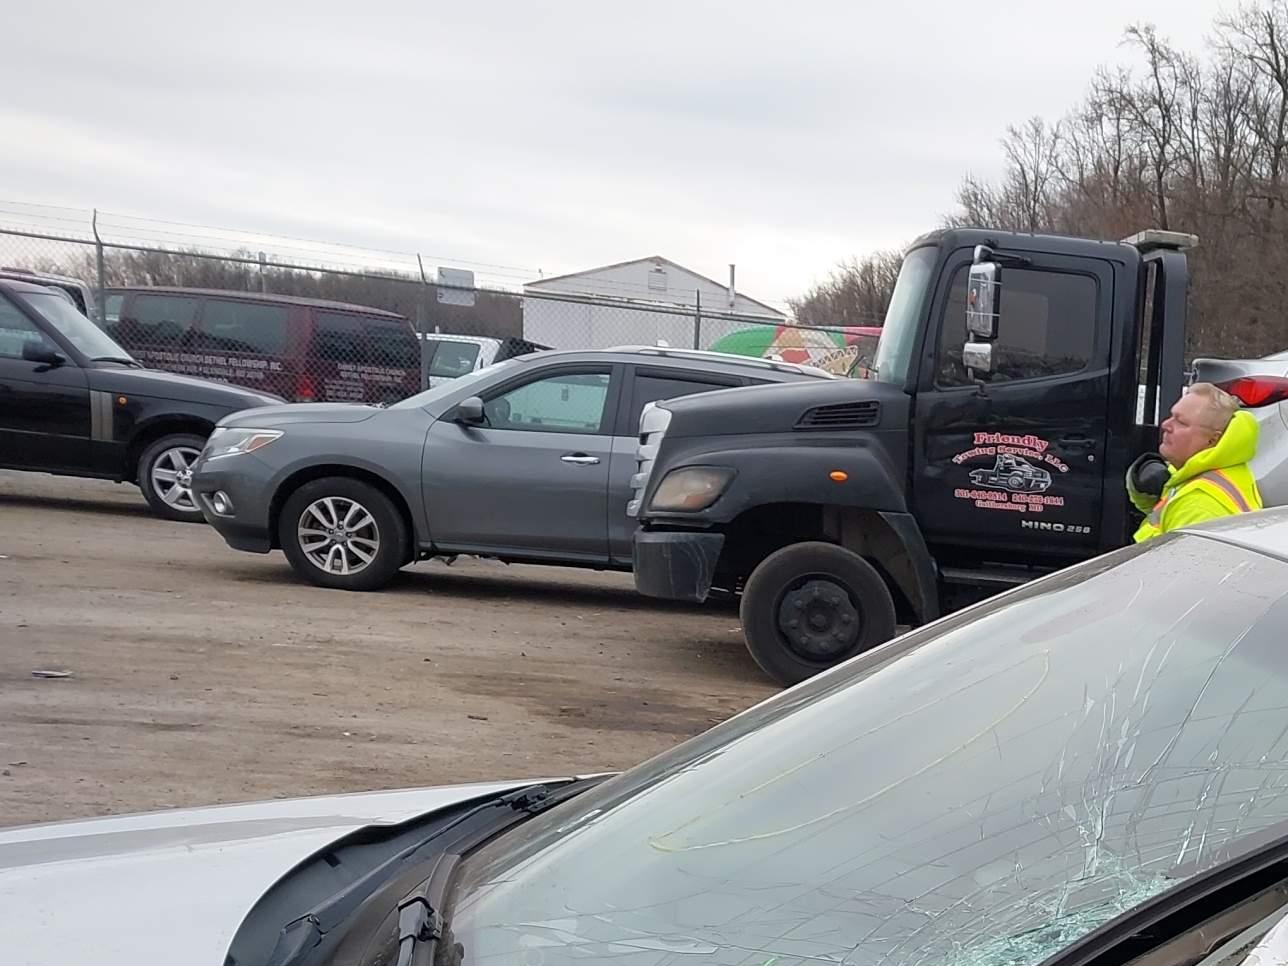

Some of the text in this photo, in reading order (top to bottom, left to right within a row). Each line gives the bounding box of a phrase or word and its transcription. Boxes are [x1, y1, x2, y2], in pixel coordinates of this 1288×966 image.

[974, 432, 1049, 452] Friendly
[952, 447, 996, 465] Towing
[1044, 454, 1069, 473] LLC
[1021, 519, 1065, 532] HINO
